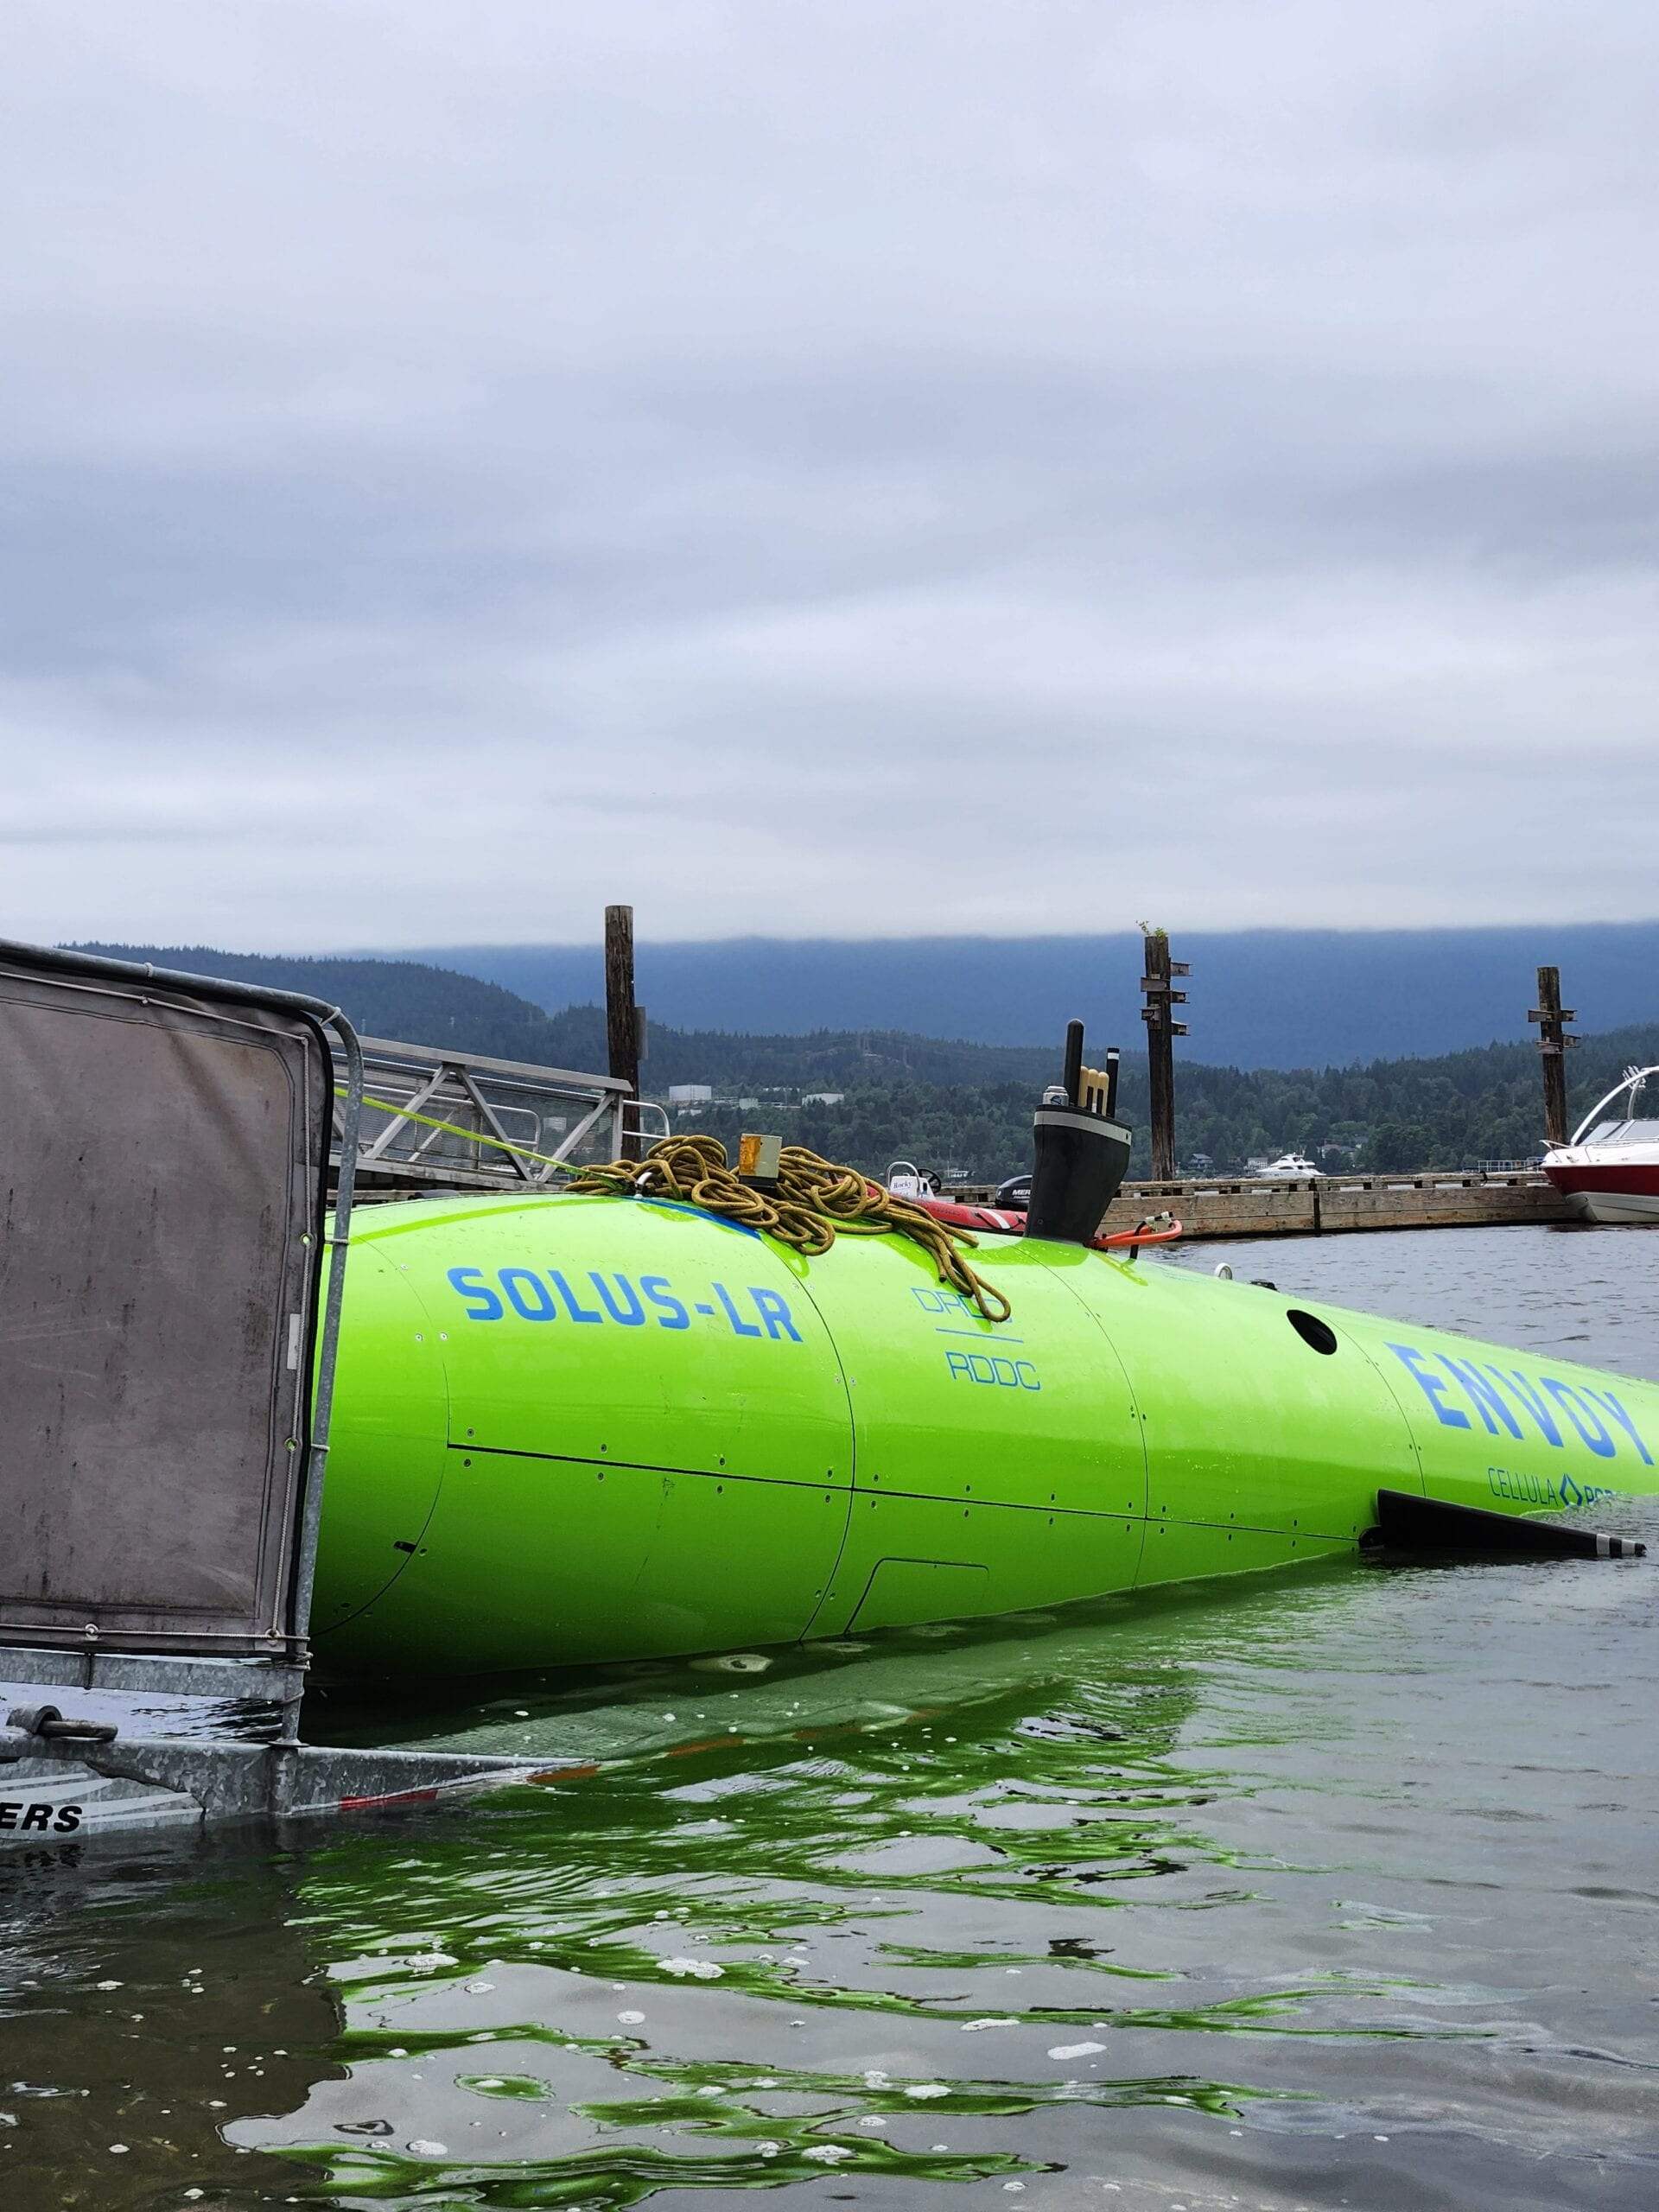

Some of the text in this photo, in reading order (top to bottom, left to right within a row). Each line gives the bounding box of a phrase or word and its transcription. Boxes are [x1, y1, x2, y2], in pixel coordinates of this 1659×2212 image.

[446, 1267, 804, 1343] SOLUS-LR
[945, 1351, 1040, 1390] RDDC
[1382, 1341, 1655, 1466] ENVOY
[1487, 1467, 1559, 1507] CELLULA
